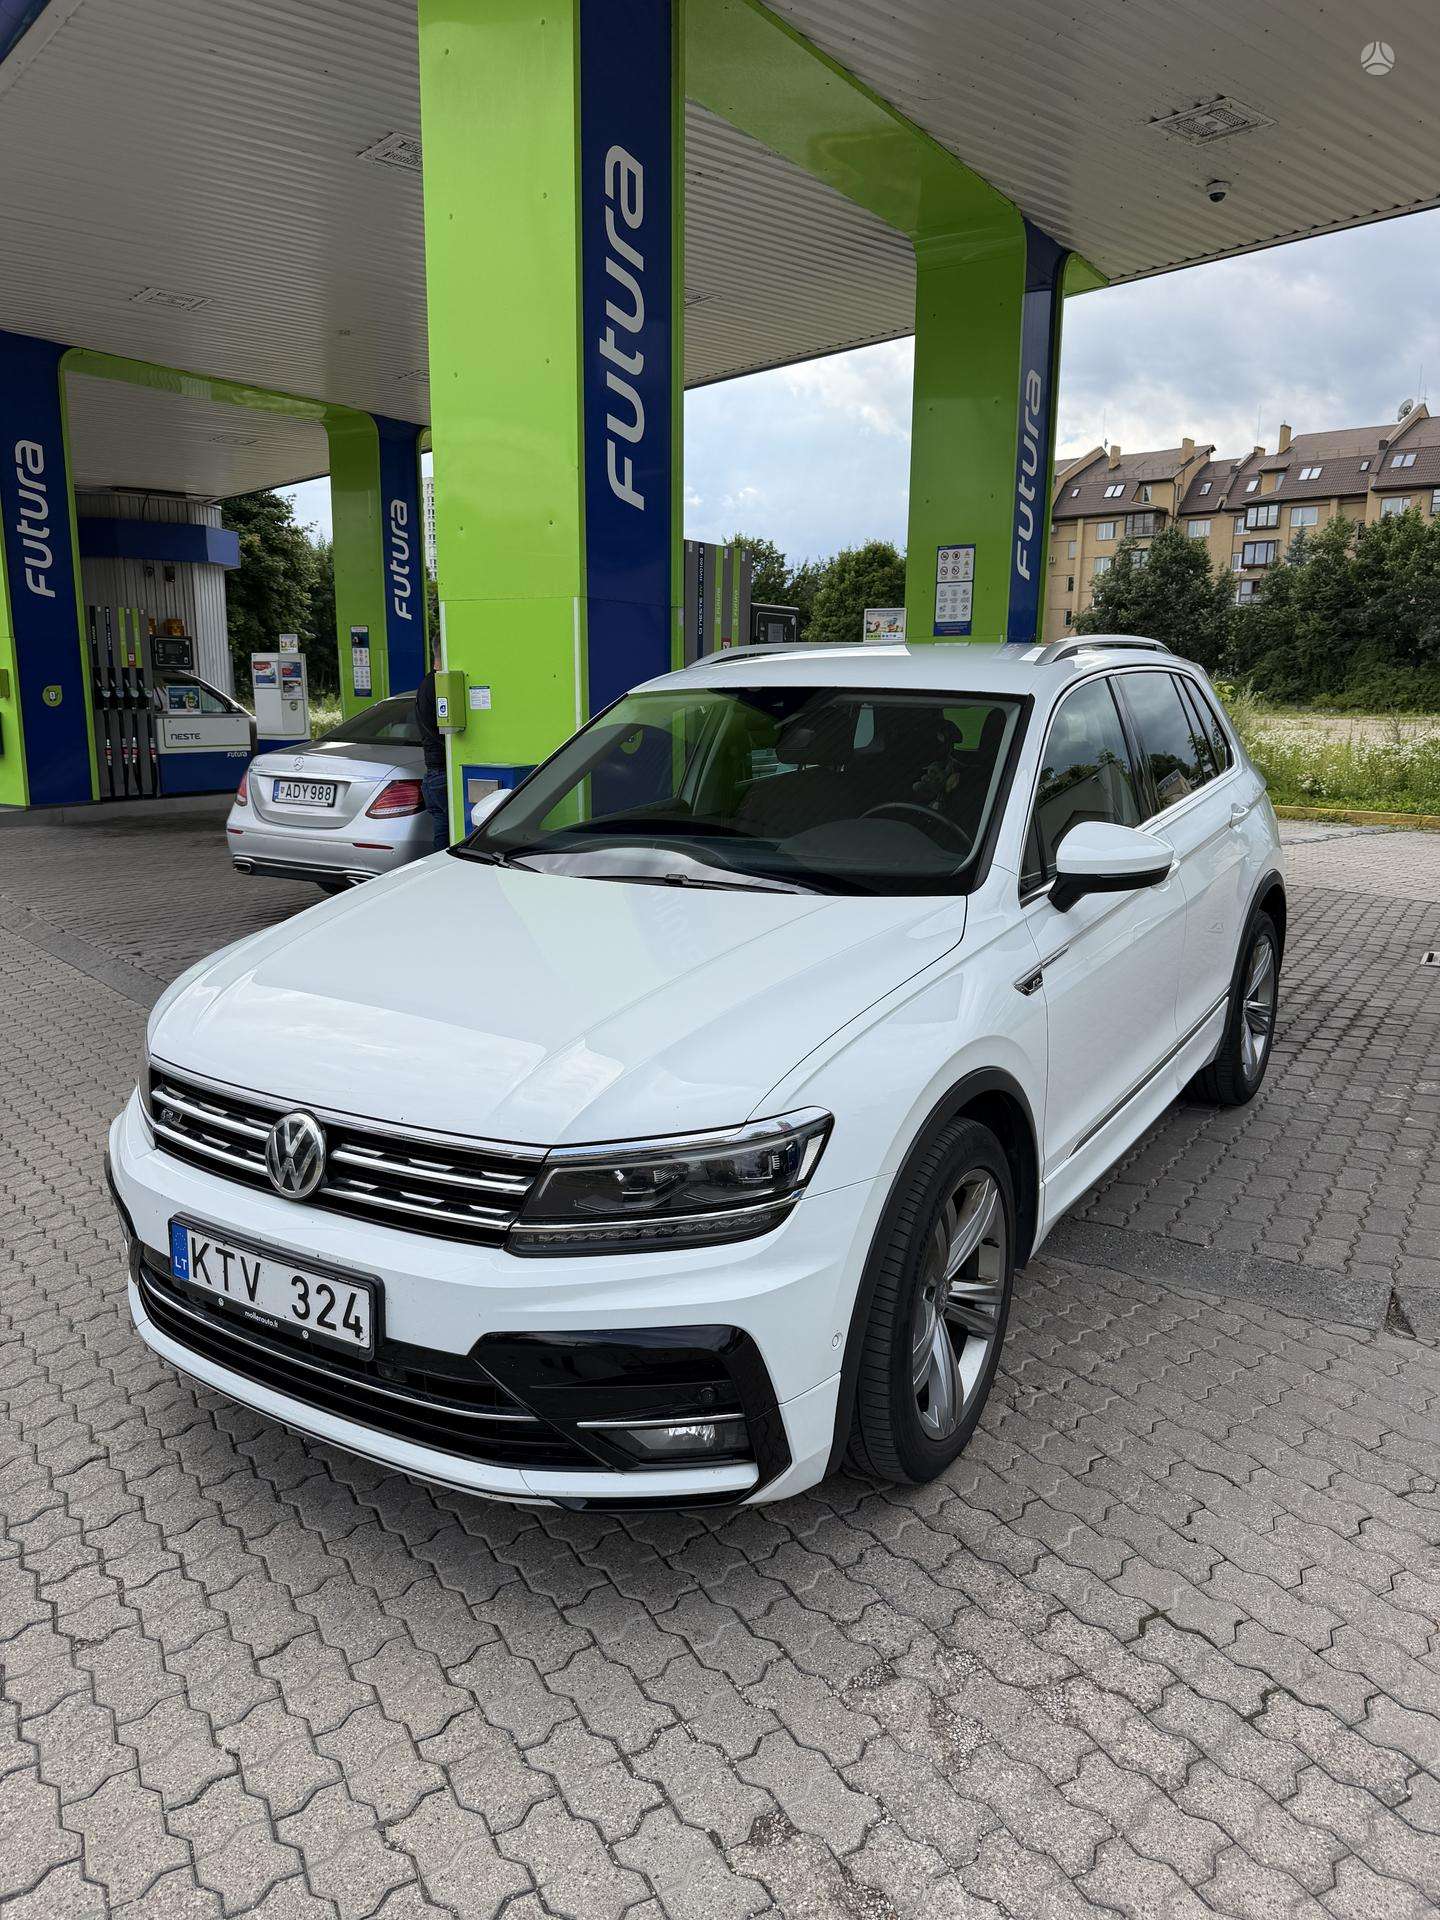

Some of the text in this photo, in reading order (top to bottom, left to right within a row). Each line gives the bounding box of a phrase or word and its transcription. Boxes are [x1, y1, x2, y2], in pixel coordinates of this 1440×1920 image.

[174, 1236, 363, 1339] LT KTV 324
